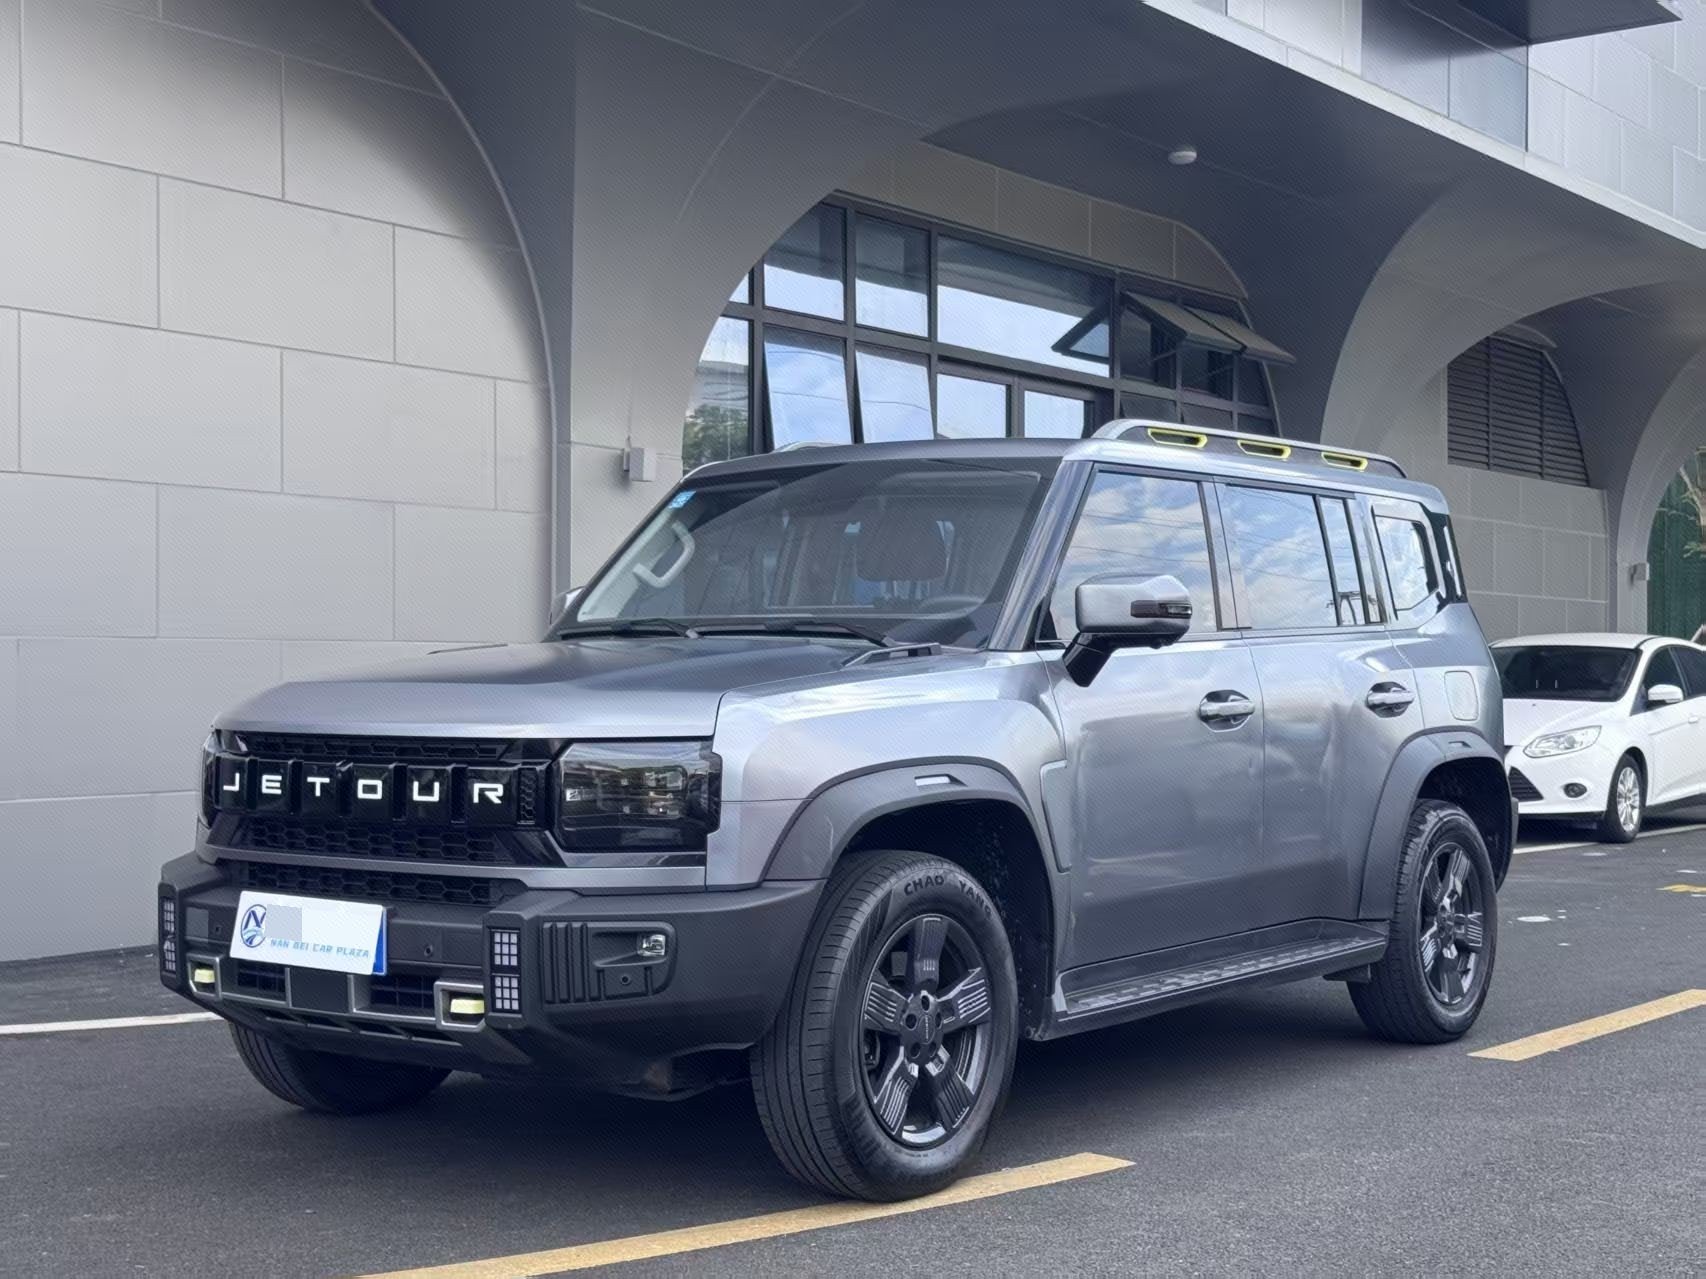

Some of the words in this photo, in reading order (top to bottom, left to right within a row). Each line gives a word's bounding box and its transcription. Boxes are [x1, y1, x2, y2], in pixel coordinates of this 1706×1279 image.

[223, 772, 504, 804] JETOUR
[904, 875, 945, 896] CHAO
[313, 944, 333, 953] CAR
[336, 946, 369, 957] PLAZA
